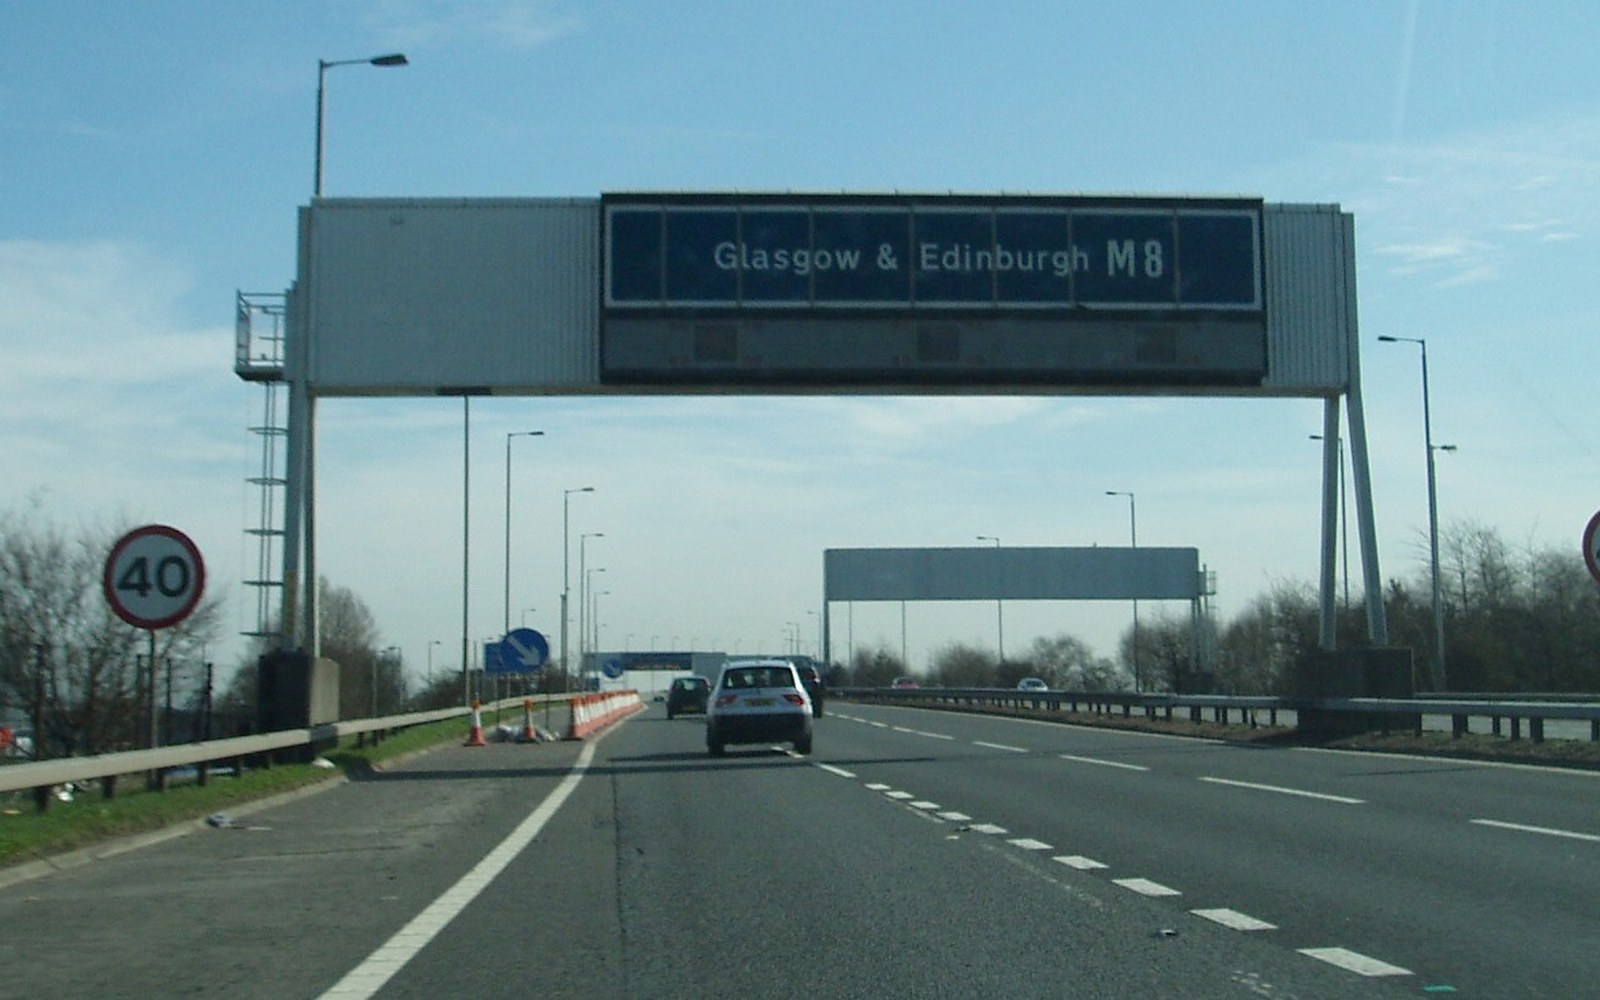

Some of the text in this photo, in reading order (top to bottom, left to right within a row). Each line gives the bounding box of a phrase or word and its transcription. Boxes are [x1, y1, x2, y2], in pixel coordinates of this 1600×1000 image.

[714, 241, 860, 275] Glasgow
[877, 243, 898, 271] &
[919, 243, 1089, 277] Edinburgh
[118, 556, 190, 598] 40
